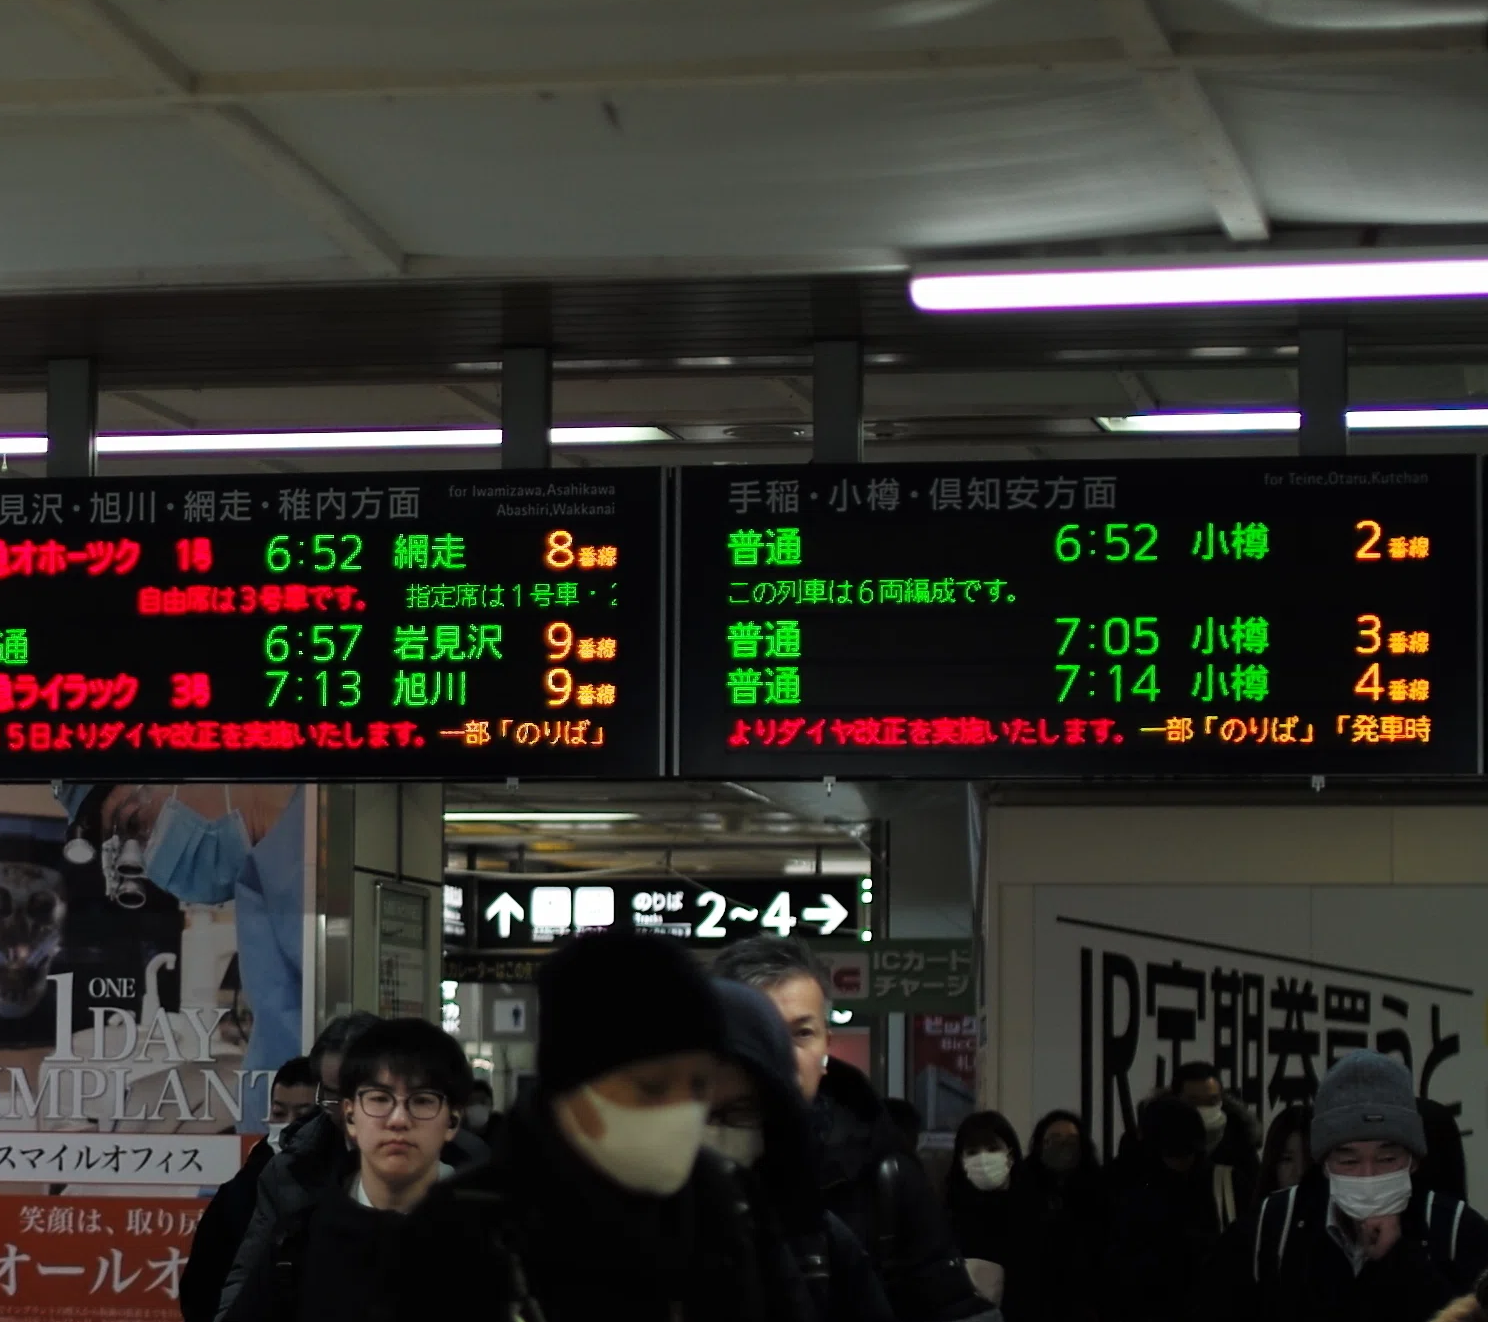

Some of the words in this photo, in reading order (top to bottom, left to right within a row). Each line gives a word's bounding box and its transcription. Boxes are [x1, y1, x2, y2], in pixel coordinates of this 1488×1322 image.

[449, 485, 468, 499] for
[472, 483, 616, 499] Iwamizawa,Asahikawa
[727, 475, 1118, 514] 手稲・小樽・倶知安方面
[496, 501, 616, 518] Abashiri,Wakkanai
[267, 535, 362, 572] 6:52
[394, 533, 466, 569] 網走
[728, 528, 802, 565] 普通
[1056, 524, 1157, 561] 6:52
[1192, 522, 1269, 560] 小樽
[1356, 520, 1429, 561] 2番線
[138, 584, 366, 614] 自由席は3号車です。
[730, 578, 1015, 604] この列車は6両編成です。
[265, 625, 362, 662] 6:57
[394, 624, 502, 660] 岩見沢
[728, 621, 801, 658] 普通
[1056, 617, 1158, 655] 7:05
[1192, 617, 1269, 654] 小樽
[1356, 614, 1429, 654] 3番線
[266, 671, 360, 706] 7:13
[393, 670, 465, 706] 旭川
[726, 667, 801, 704] 普通
[1056, 665, 1160, 702] 7:14
[1192, 664, 1269, 701] 小樽
[1354, 663, 1429, 702] 4番線
[440, 719, 603, 746] 一部「のりば」
[728, 717, 1123, 746] よりダイヤ改正を実施いたします。
[632, 890, 684, 912] のりば
[874, 949, 971, 972] ICカード
[88, 977, 136, 999] ONE
[875, 976, 969, 997] チャージ
[45, 972, 83, 1062] 1
[88, 1006, 232, 1062] DAY
